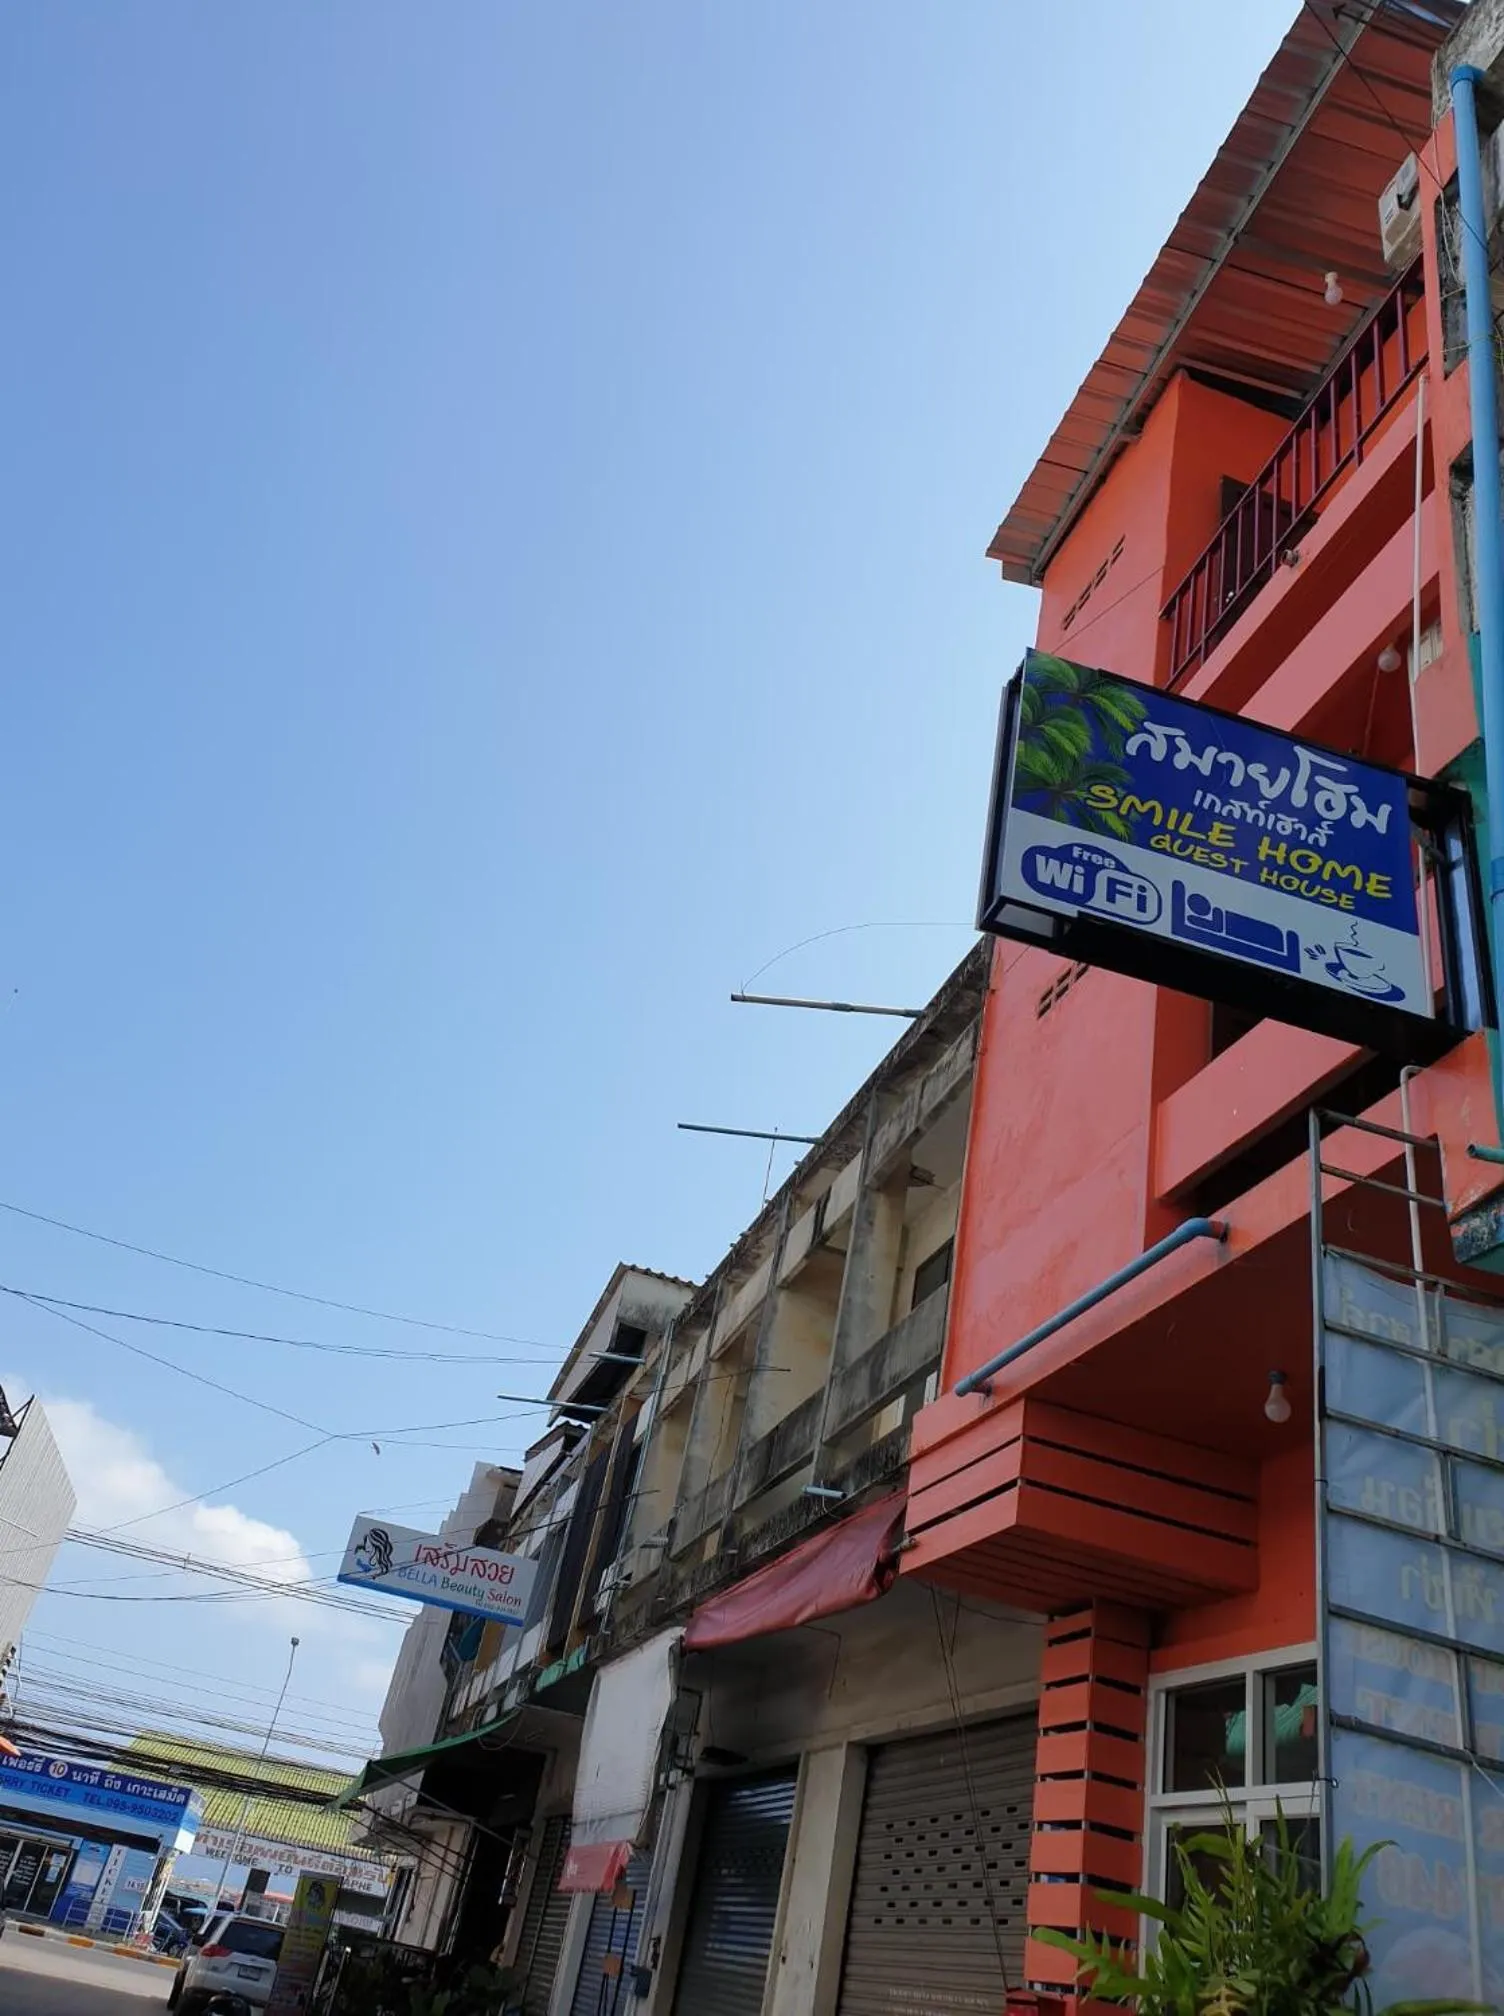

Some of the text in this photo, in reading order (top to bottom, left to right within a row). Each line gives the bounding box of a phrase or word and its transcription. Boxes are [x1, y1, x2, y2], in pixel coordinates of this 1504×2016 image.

[1125, 721, 1392, 834] สมายโฮม
[1193, 789, 1335, 848] เกสท์เฮาส์
[1072, 844, 1117, 870] Free
[1085, 784, 1393, 899] SMILE HOME
[1150, 834, 1355, 910] GUEST HOUSE
[413, 1542, 515, 1585] เสริมสวย
[397, 1566, 522, 1606] BELLA Beauty Salon
[31, 1780, 72, 1800] TICKET
[51, 1761, 66, 1777] 10
[72, 1770, 101, 1785] นาที
[206, 1846, 259, 1867] WELOME
[278, 1863, 293, 1875] TO
